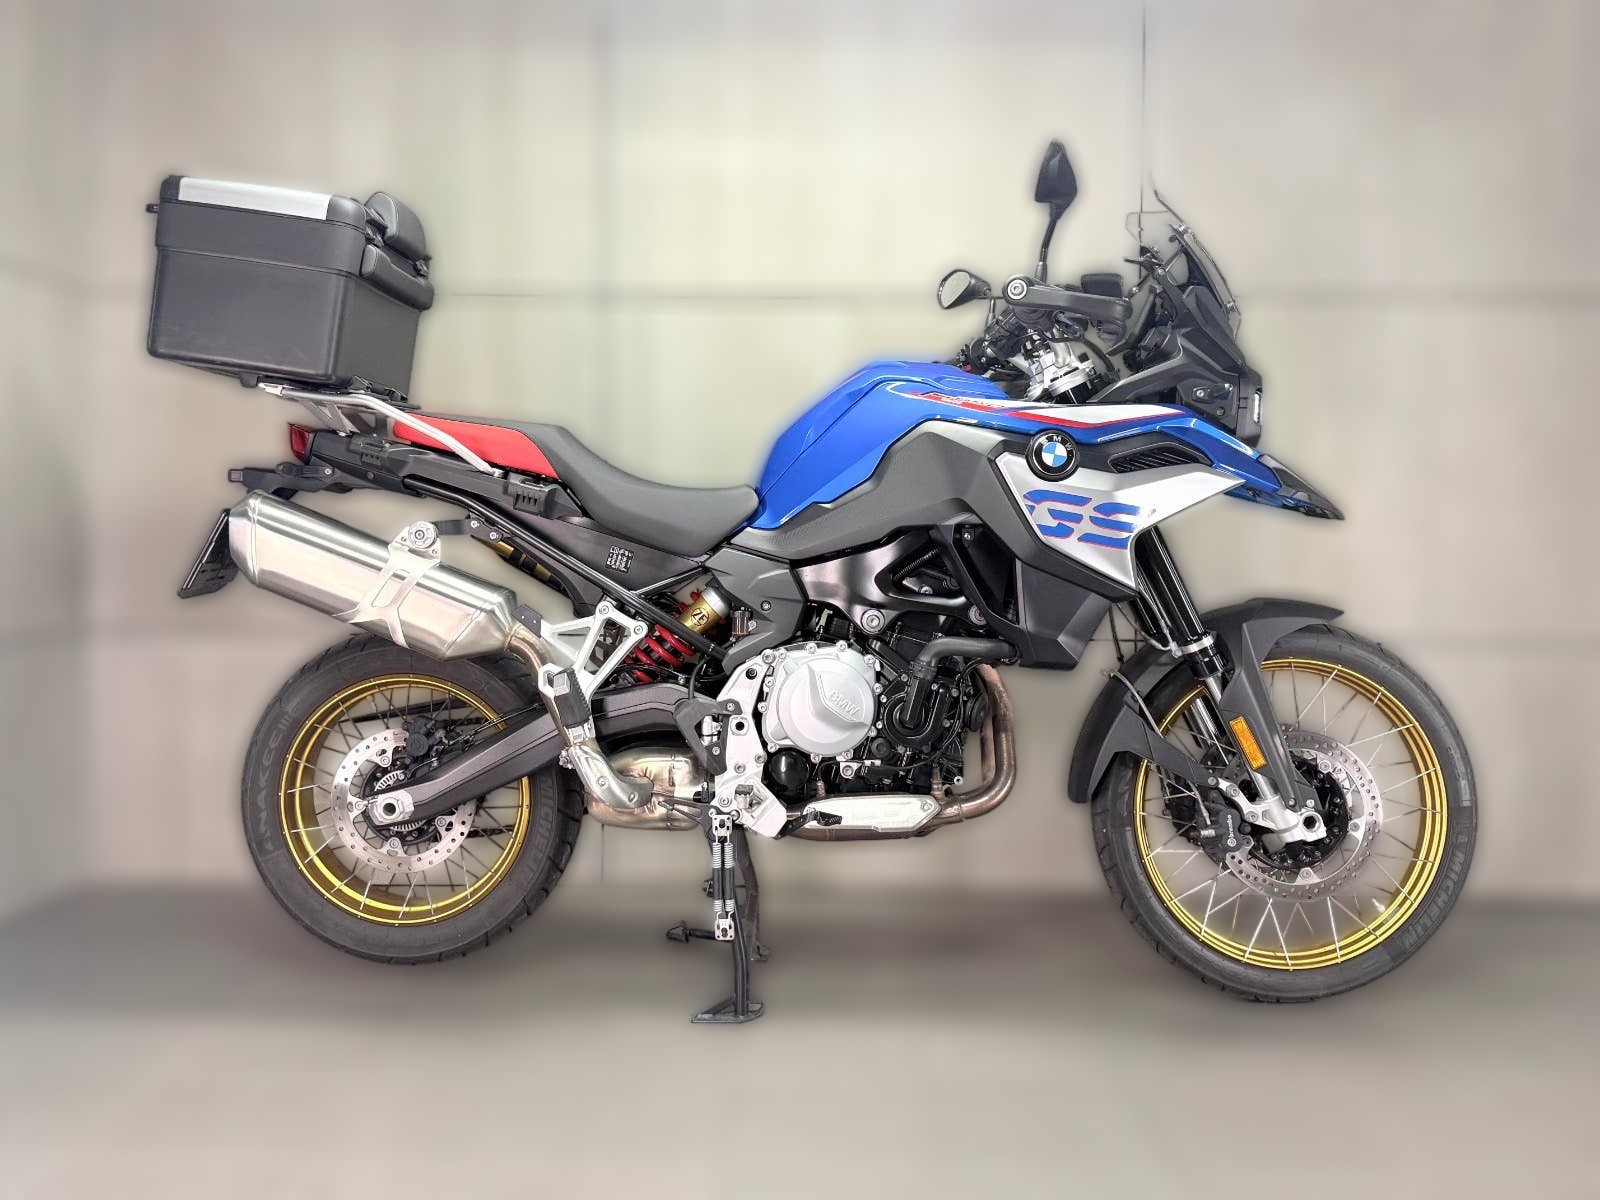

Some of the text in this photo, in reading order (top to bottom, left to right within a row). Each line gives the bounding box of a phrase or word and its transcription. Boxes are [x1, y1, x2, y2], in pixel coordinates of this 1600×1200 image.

[1039, 435, 1073, 451] BMW
[1023, 490, 1140, 550] GS
[830, 690, 861, 716] BMW
[256, 731, 283, 850] ANAKEE
[1402, 851, 1465, 948] MICHELIN
